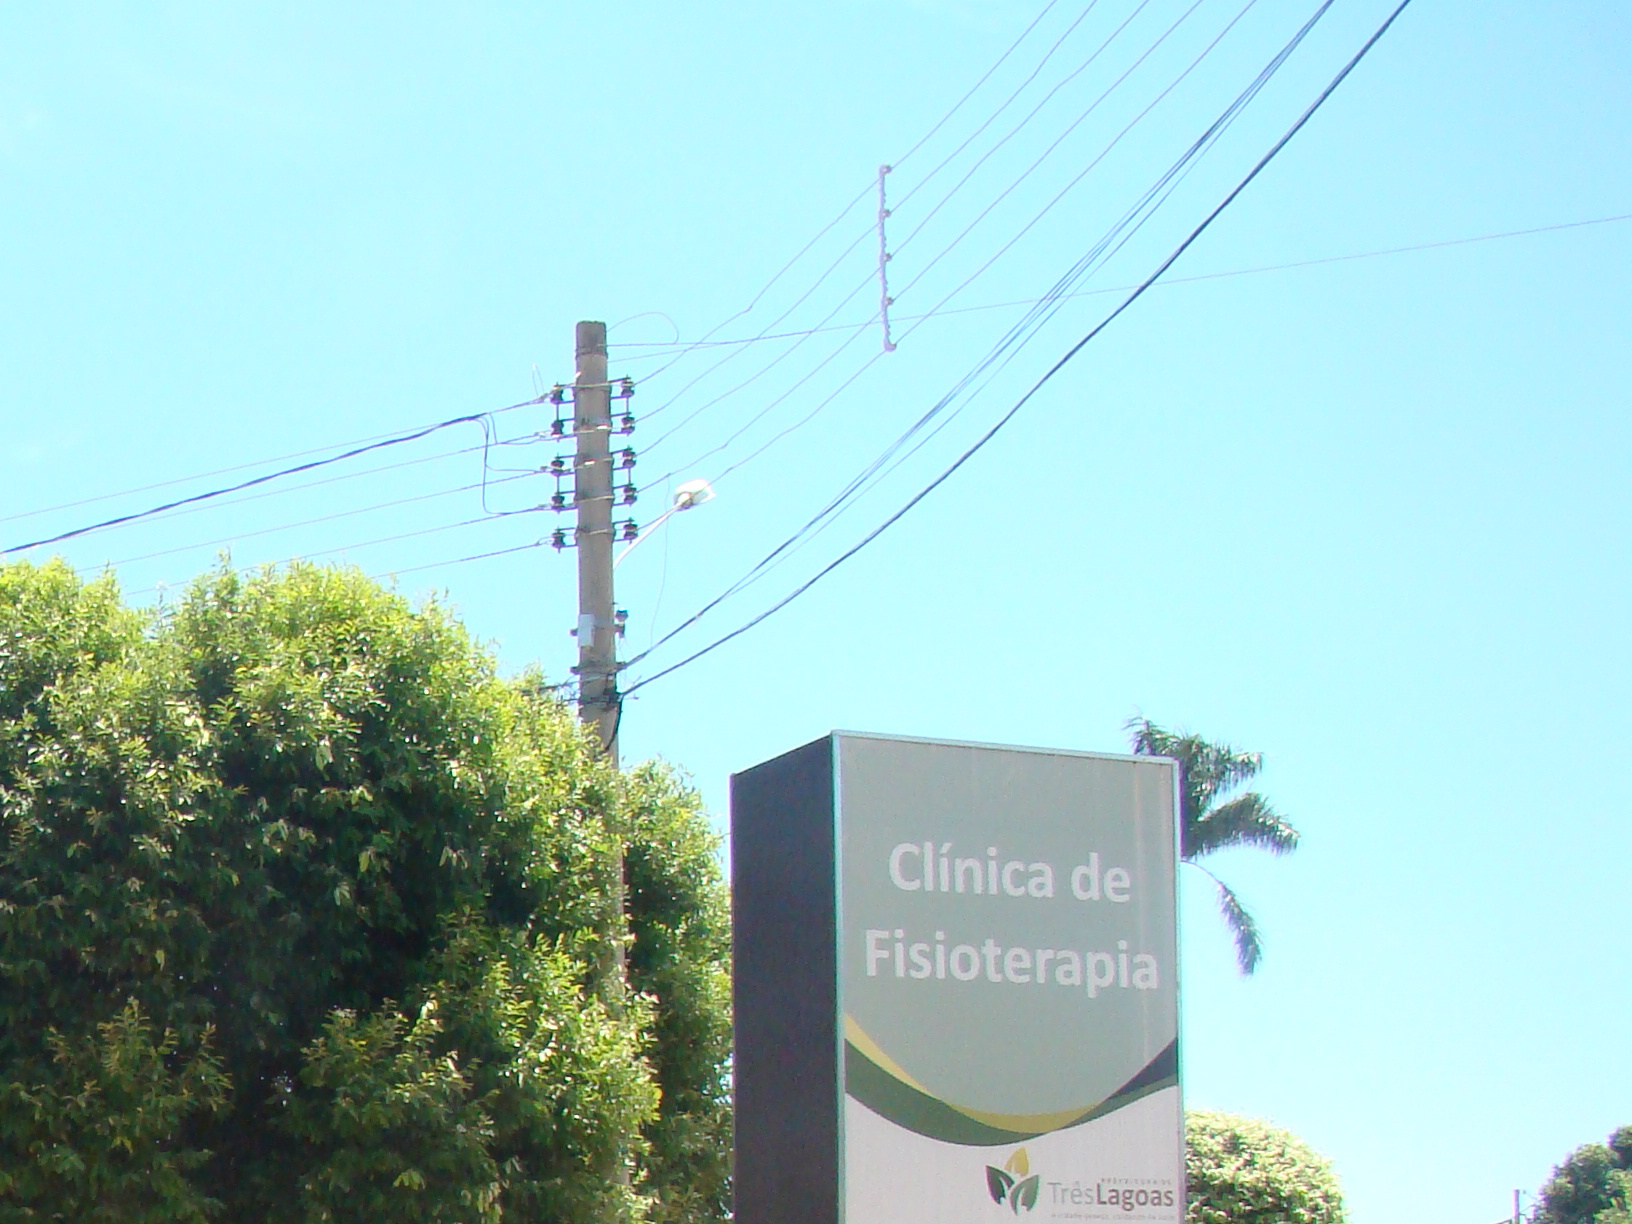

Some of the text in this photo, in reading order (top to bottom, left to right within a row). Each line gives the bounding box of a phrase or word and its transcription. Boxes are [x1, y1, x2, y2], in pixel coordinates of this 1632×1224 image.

[887, 841, 1131, 903] Clínica de
[865, 928, 1159, 999] Fisioterapia
